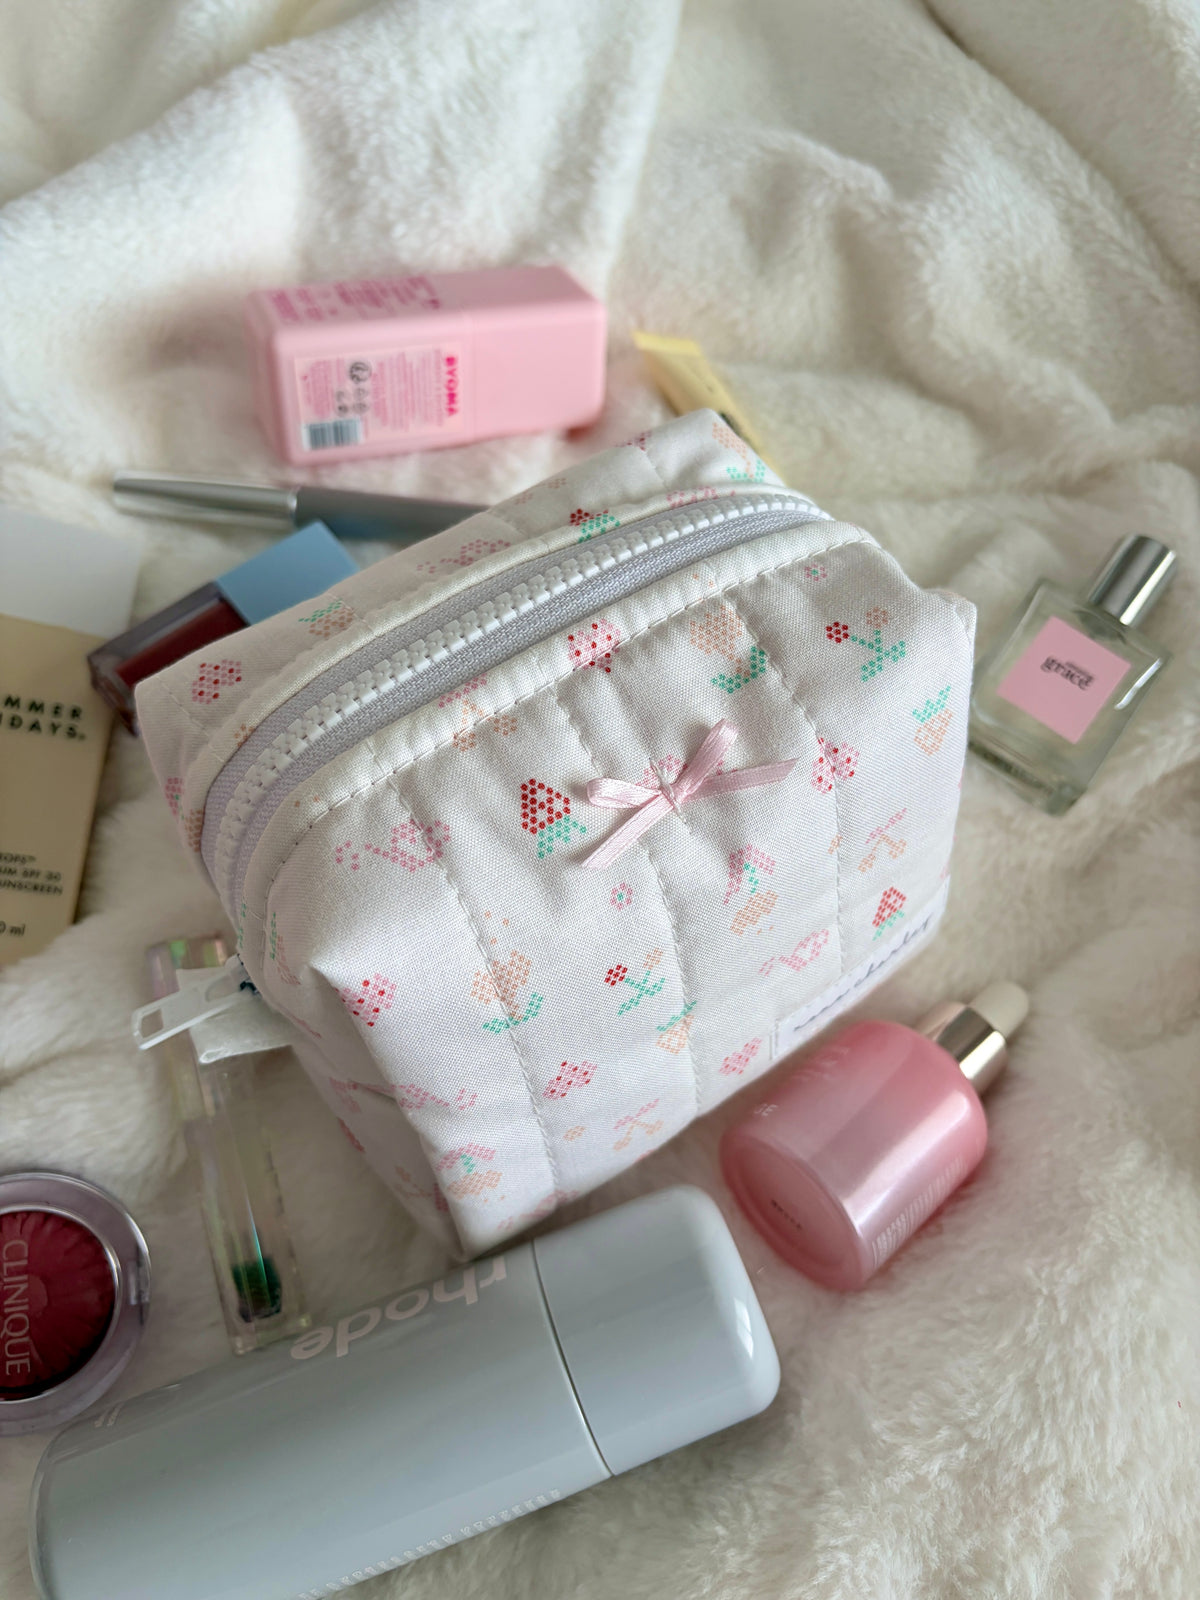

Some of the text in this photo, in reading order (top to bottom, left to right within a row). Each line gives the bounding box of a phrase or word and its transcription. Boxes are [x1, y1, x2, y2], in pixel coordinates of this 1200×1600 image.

[4, 695, 83, 720] MMER
[9, 923, 26, 937] ml
[1, 1239, 31, 1375] CLINIQUE
[291, 1255, 507, 1360] rhode
